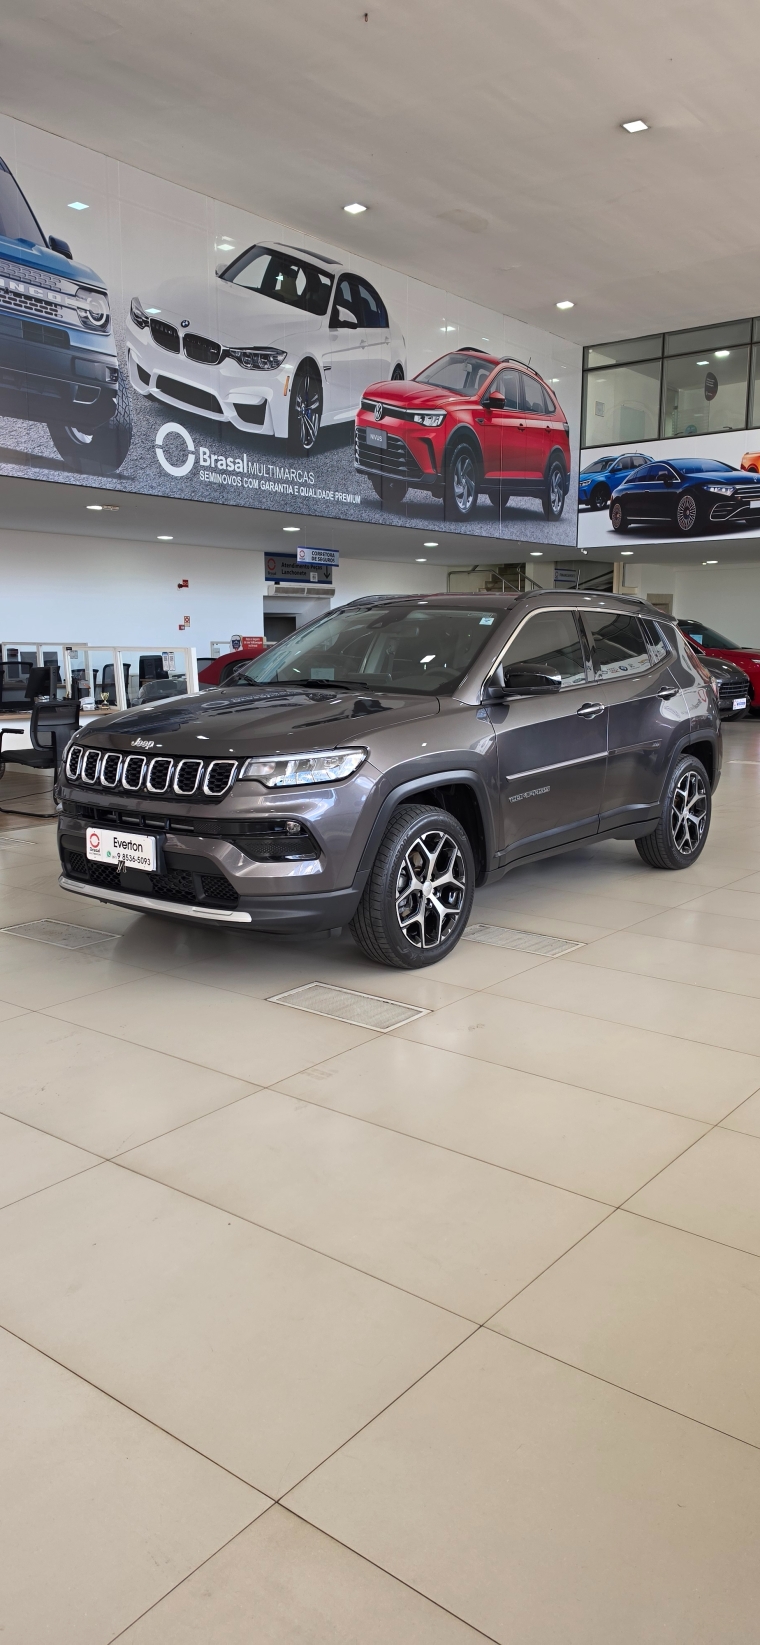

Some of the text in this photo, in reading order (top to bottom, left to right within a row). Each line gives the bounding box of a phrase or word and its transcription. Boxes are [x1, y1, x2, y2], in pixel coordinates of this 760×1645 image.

[200, 447, 315, 484] Brasal MULTIMARCAS
[200, 470, 361, 504] SEMINOVOS COM GARANTIA E QUALIDADE PREMIUM
[131, 737, 154, 750] Jeep
[113, 837, 143, 852] Everton
[122, 853, 151, 865] 8536-5093
